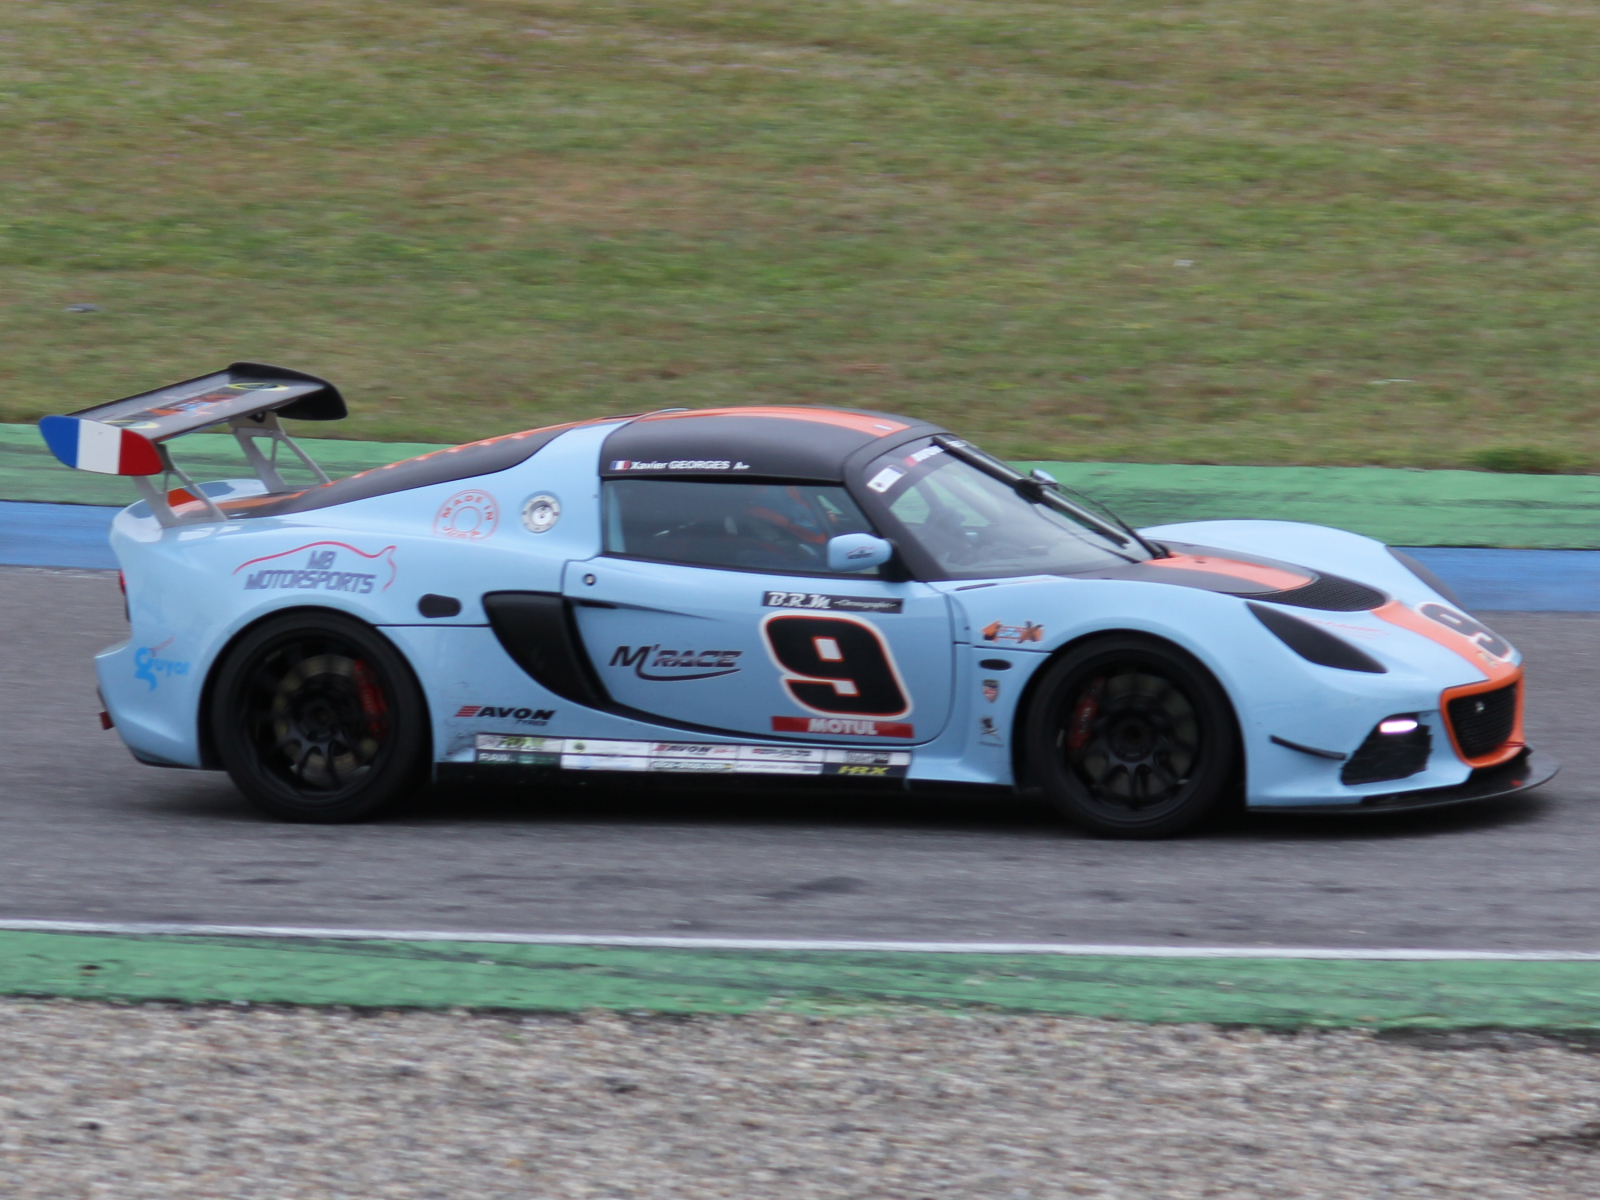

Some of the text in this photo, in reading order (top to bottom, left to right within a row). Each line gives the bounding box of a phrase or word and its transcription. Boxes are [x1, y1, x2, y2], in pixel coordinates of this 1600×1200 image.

[630, 460, 668, 470] Xavier
[668, 460, 731, 470] GEORGES
[441, 495, 494, 521] MADE IN
[306, 550, 337, 569] MB
[244, 569, 376, 594] MOTORSPORTS
[1416, 602, 1513, 663] 9
[758, 609, 914, 721] 9
[477, 706, 557, 720] AVON
[808, 718, 878, 735] MOTUL
[837, 765, 891, 776] HRX
